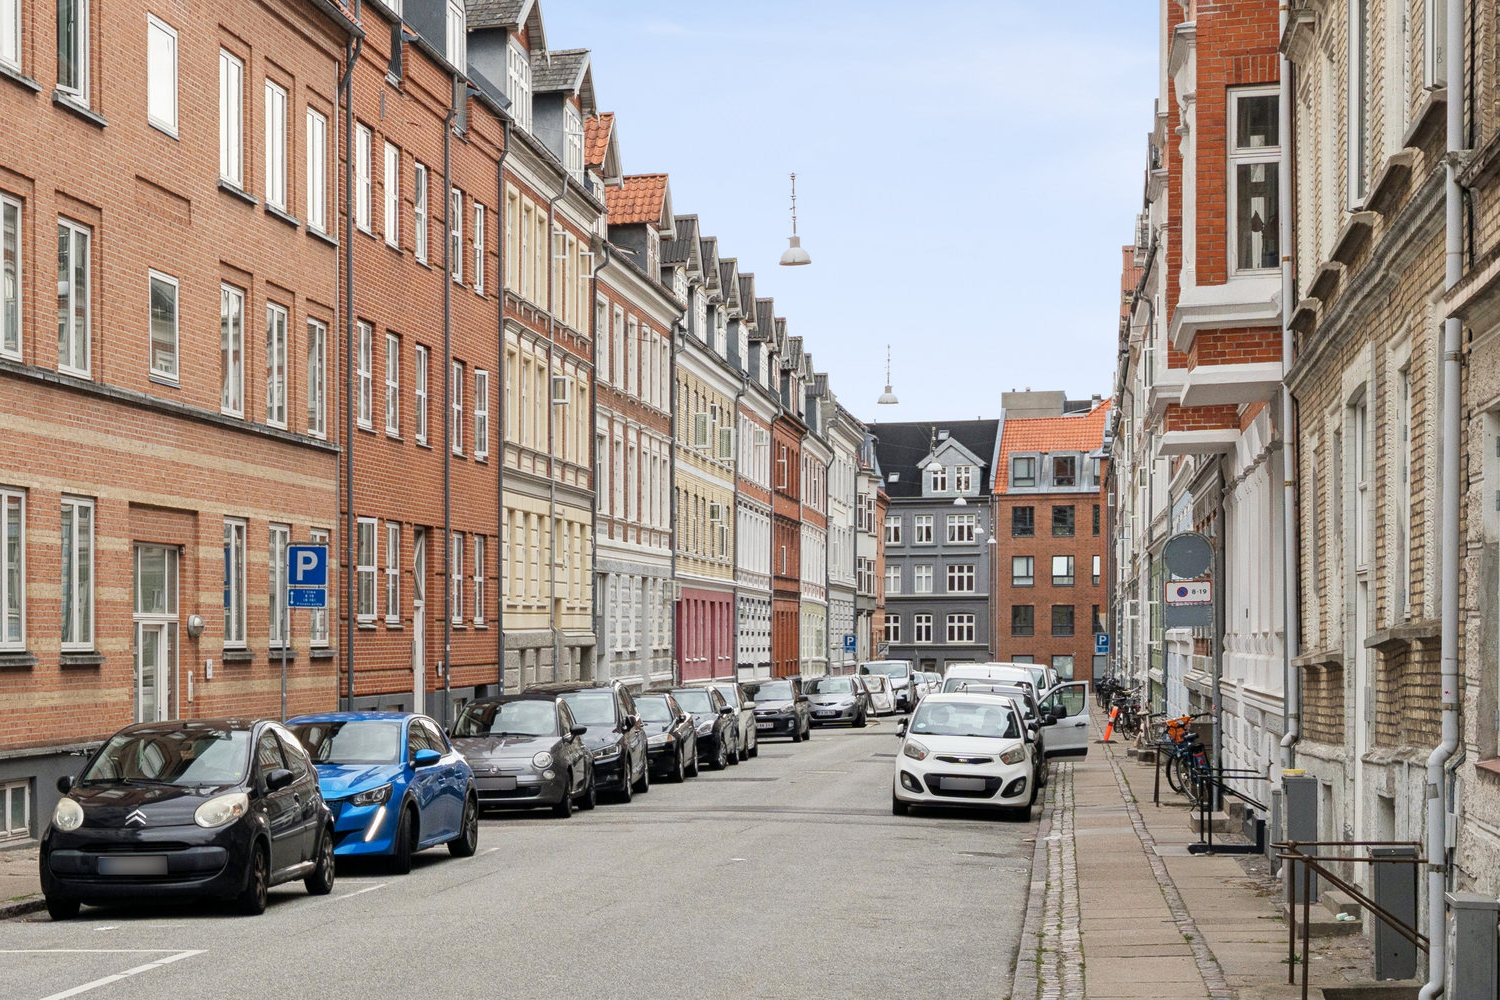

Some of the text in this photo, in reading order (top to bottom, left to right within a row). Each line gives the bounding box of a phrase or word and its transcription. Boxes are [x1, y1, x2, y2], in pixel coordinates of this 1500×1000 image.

[297, 550, 318, 581] P
[846, 636, 854, 645] P
[1099, 635, 1107, 645] P
